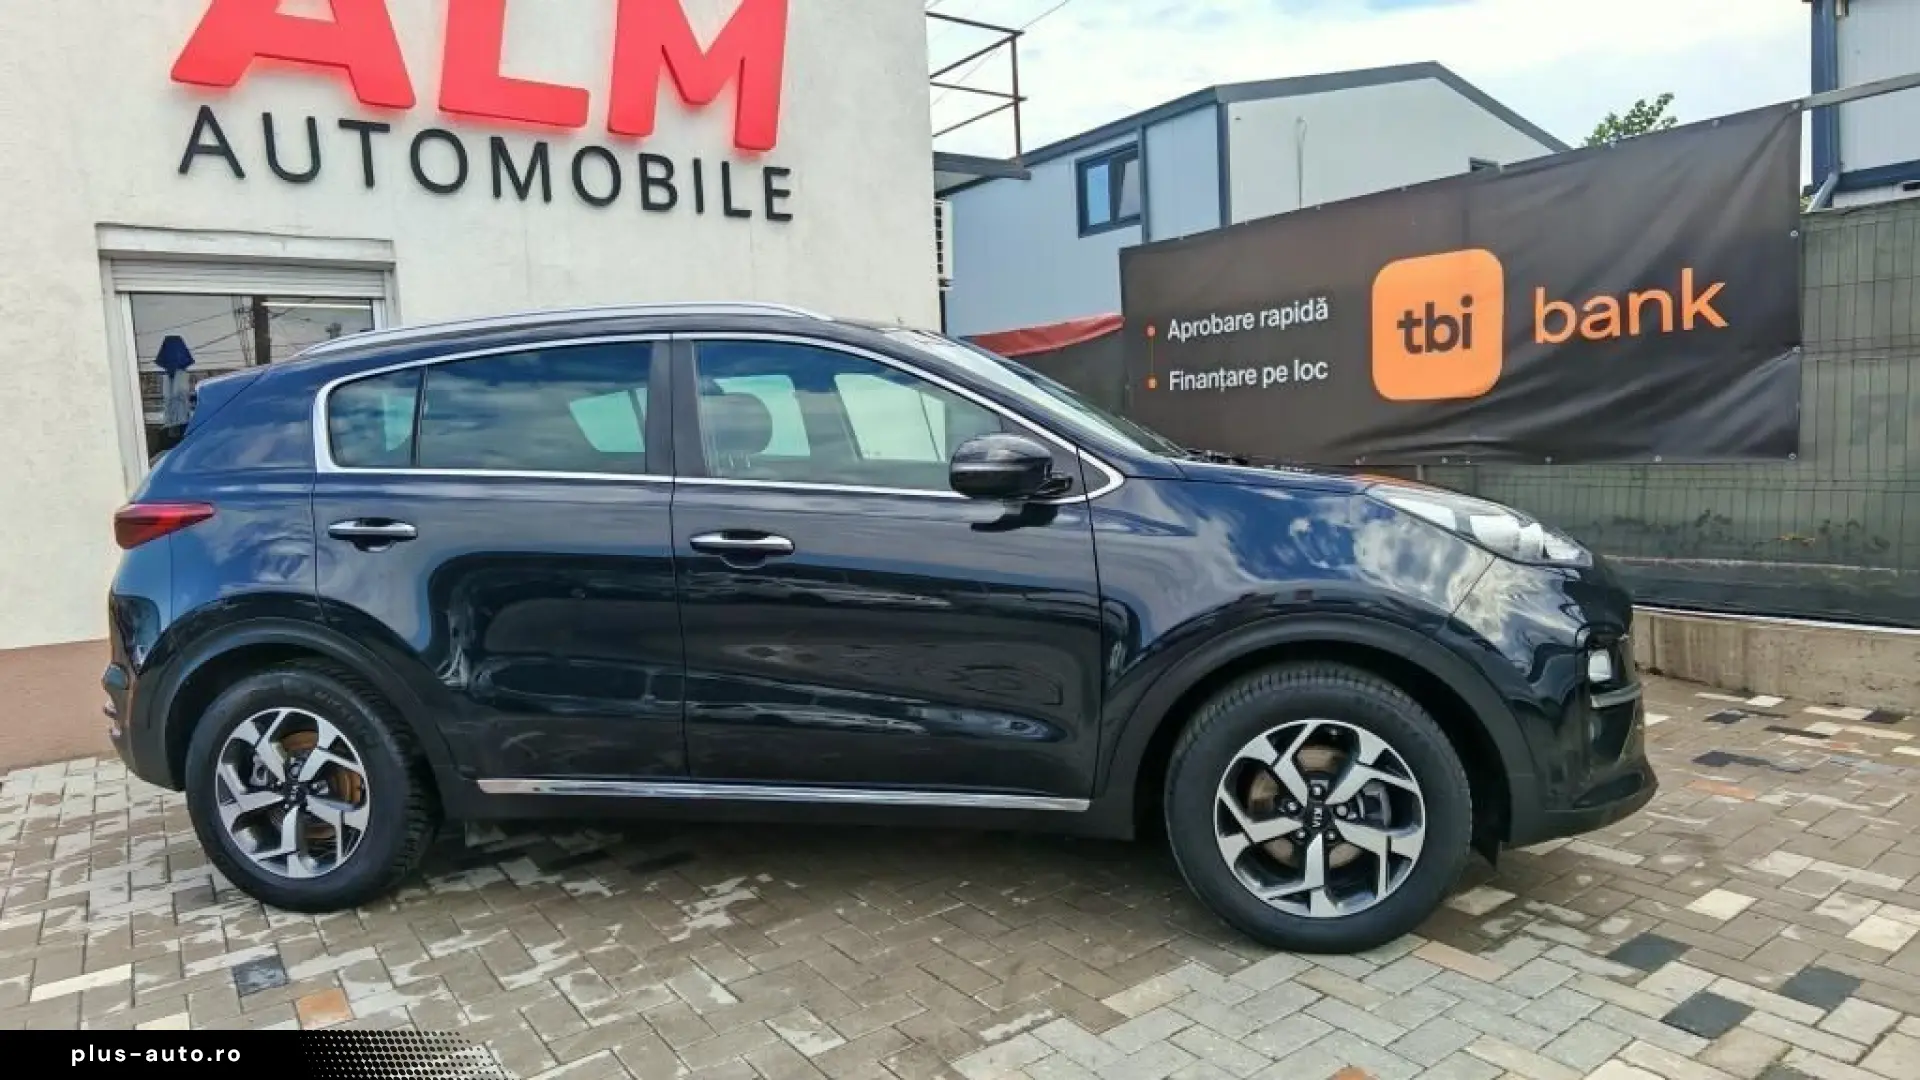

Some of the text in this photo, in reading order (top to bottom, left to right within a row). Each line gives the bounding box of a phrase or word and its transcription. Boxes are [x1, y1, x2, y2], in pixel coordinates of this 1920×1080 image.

[170, 0, 788, 151] ALM
[178, 105, 793, 222] AUTOMOBILE
[1168, 296, 1329, 343] Aprobare rapidă
[1397, 267, 1729, 355] tbi bank
[1169, 359, 1329, 393] Finanțare pe loc
